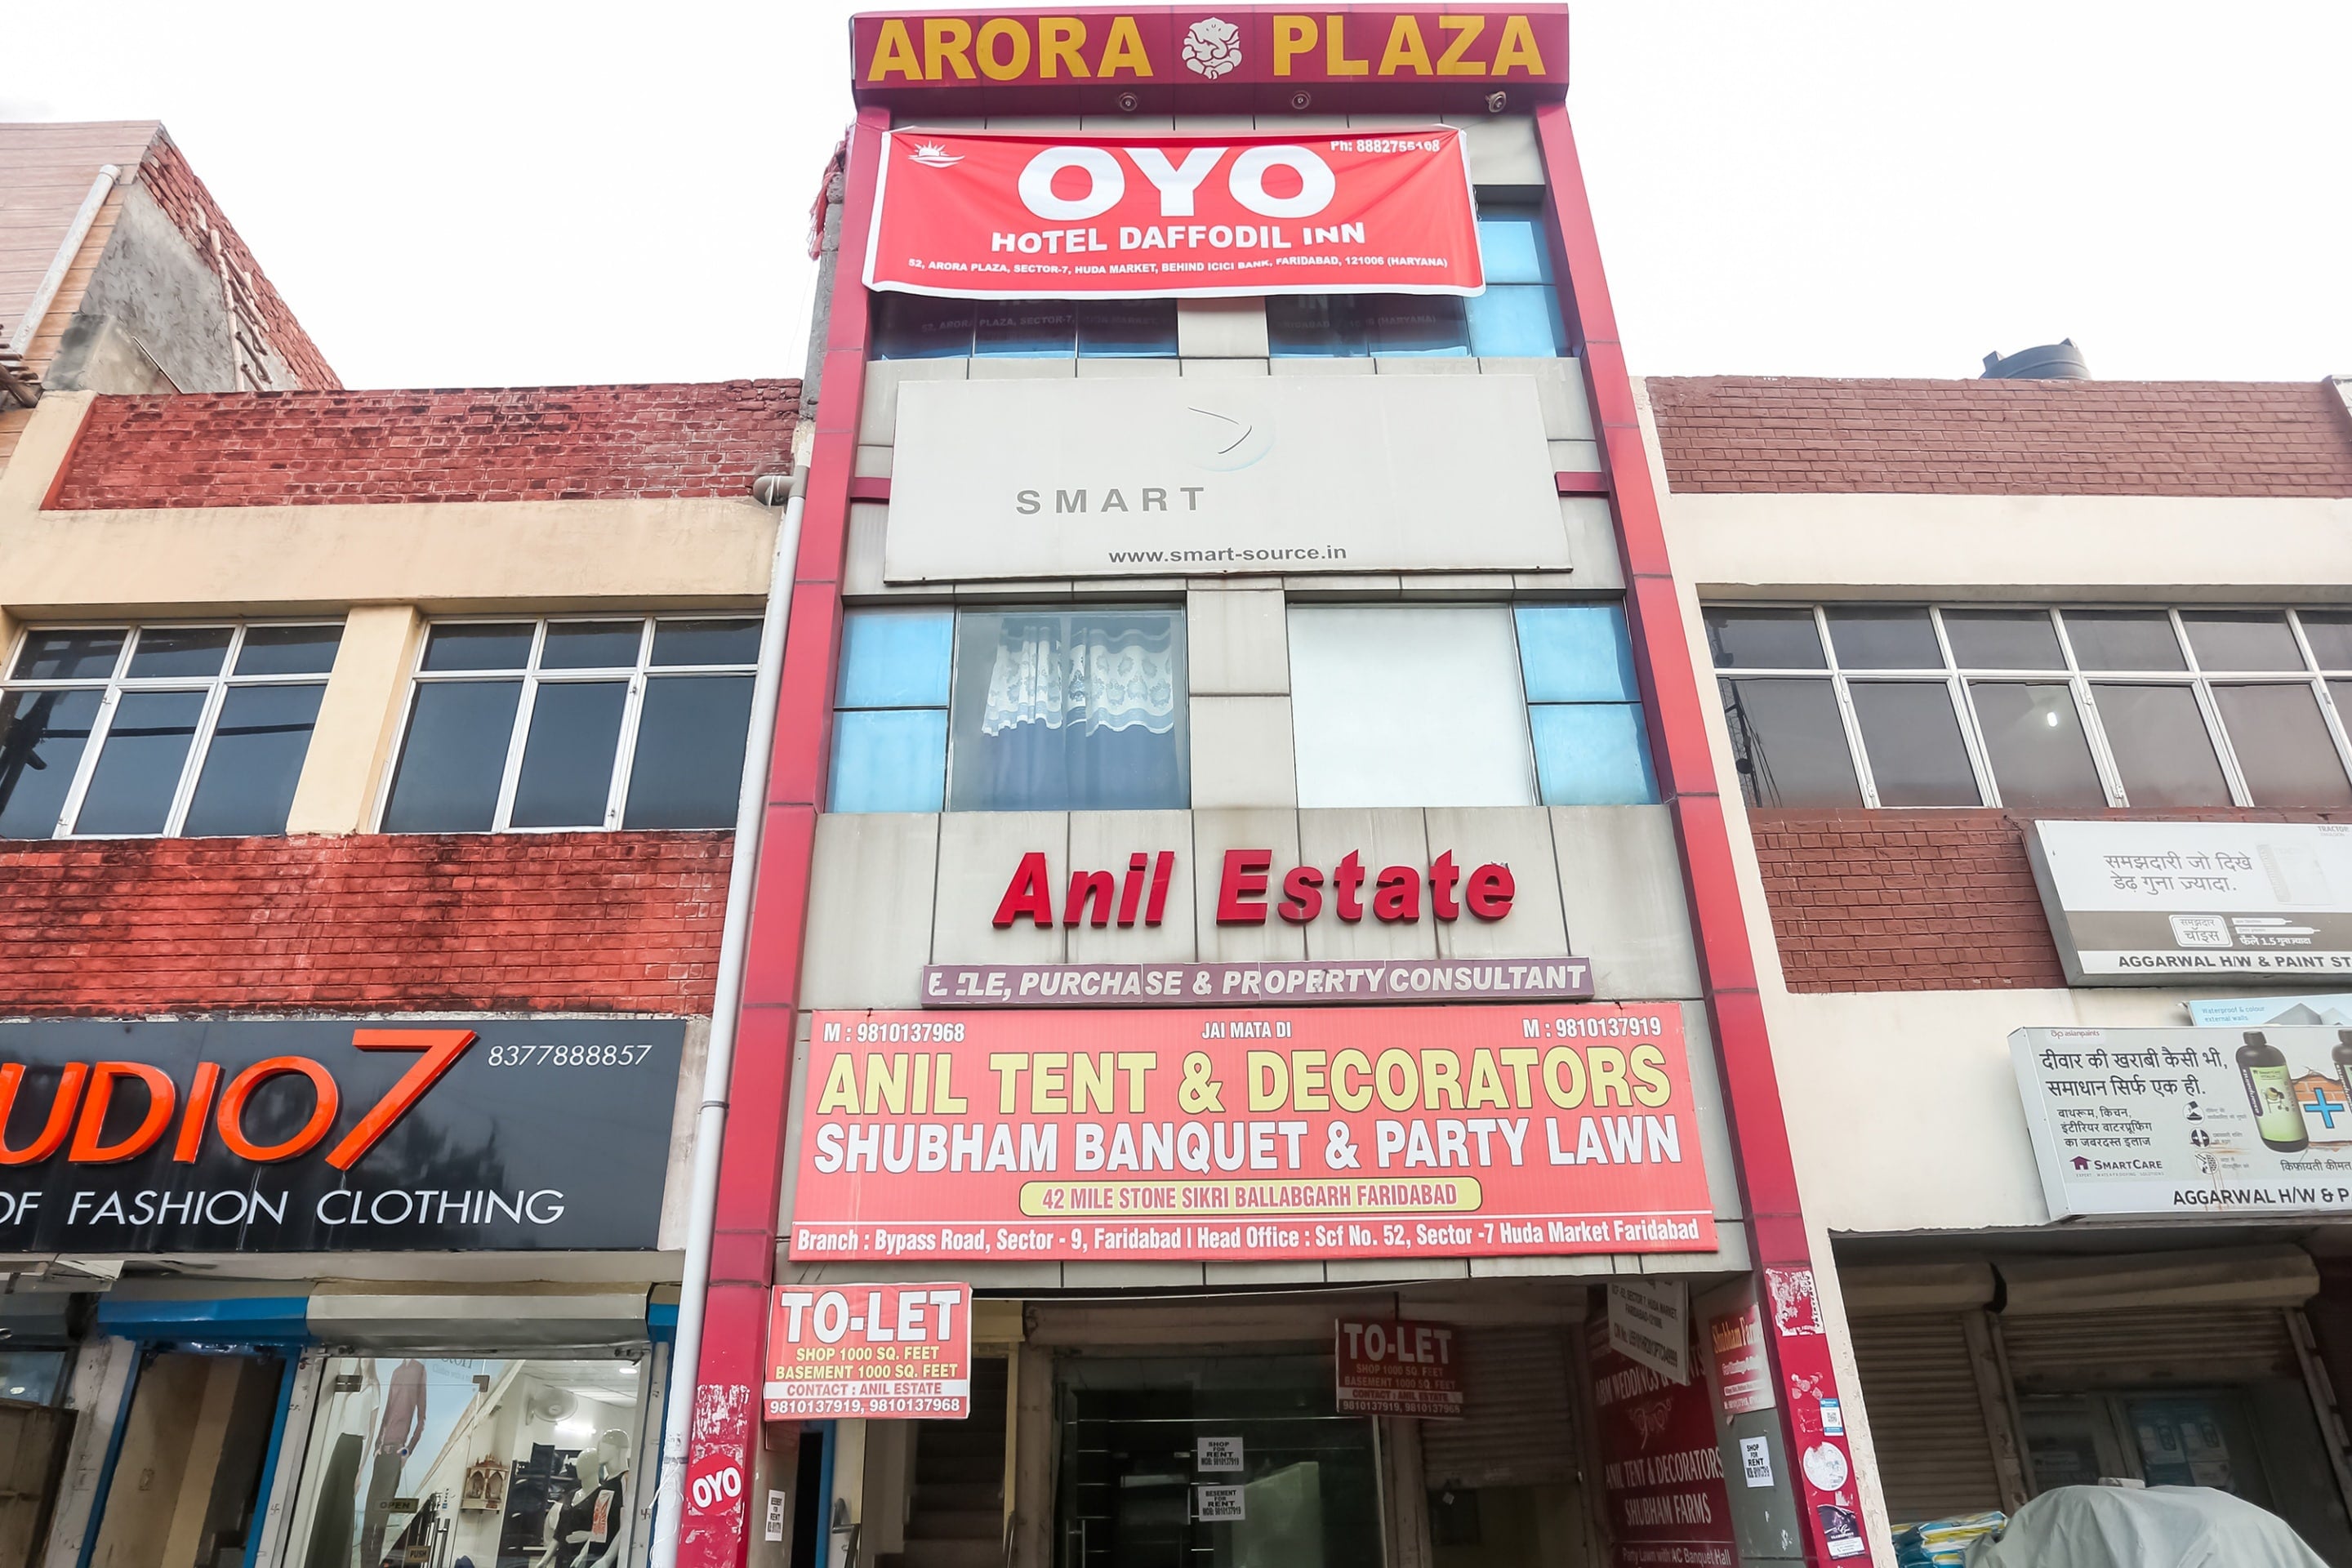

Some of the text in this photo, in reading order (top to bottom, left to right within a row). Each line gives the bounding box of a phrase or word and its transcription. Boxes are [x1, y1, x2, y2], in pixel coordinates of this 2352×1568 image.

[867, 15, 1546, 82] ARORA PLAZA
[1330, 140, 1353, 153] Ph:
[1018, 145, 1336, 221] OYO
[991, 222, 1365, 254] HOTEL DAFFODIL INN
[908, 256, 1448, 275] 52, ARORA PLAZA, SECTOR-7, HUDA MARKET, BEHIND ICICI BANK, FARIDABAD, 121006 (HARYANA)
[1016, 487, 1204, 514] SMART
[1108, 545, 1348, 563] www.smart-source.in
[2104, 851, 2253, 871] समझदारी जो दिखे
[992, 848, 1517, 929] Anil Estate
[2110, 871, 2138, 893] डेढ़
[2141, 876, 2175, 895] गुना
[2118, 956, 2324, 968] AGGARWAL H/W & PAINT
[1018, 965, 1586, 996] PURCHASE & PROPERTY CONSULTANT
[858, 1022, 965, 1043] 9810137968
[1202, 1020, 1291, 1040] JAI MATA DI
[1555, 1017, 1662, 1038] 9810137919
[488, 1044, 654, 1067] 8377888857
[2039, 1046, 2228, 1070] दीवार की खराबी कैसी भी,
[816, 1044, 1672, 1116] ANIL TENT & DECORATORS
[2046, 1074, 2206, 1097] समाधान सिर्फ एक ही.
[2099, 1105, 2132, 1118] किचन,
[813, 1114, 1682, 1175] SHUBHAM BANQUET & PARTY LAWN
[2064, 1137, 2151, 1148] का इलाज
[68, 1187, 565, 1225] FASHION CLOTHING
[1042, 1183, 1457, 1210] 42 MILE STONE SIKRI BALLABGARH FARIDABAD
[2173, 1186, 2334, 1205] AGGARWAL H/W &
[797, 1229, 858, 1251] Branch
[875, 1228, 936, 1254] Bypass
[941, 1227, 991, 1252] Road,
[996, 1227, 1054, 1250] Sector
[1071, 1227, 1088, 1252] 9,
[1094, 1226, 1181, 1250] Faridabad
[1197, 1226, 1241, 1249] Head
[1246, 1225, 1299, 1248] Office
[1316, 1224, 1346, 1247] Scf
[1348, 1224, 1377, 1246] No.
[1383, 1223, 1411, 1249] 52,
[1416, 1223, 1472, 1245] Sector
[1500, 1222, 1544, 1244] Huda
[1548, 1220, 1610, 1243] Market
[1614, 1218, 1699, 1241] Faridabad
[781, 1290, 961, 1343] TO-LET
[795, 1346, 939, 1361] SHOP 1000 SQ. FEET
[1343, 1323, 1452, 1364] TO-LET
[775, 1363, 958, 1379] BASEMENT 1000 SQ. FEET
[1356, 1364, 1379, 1374] SHOP
[1383, 1365, 1403, 1375] 1000
[1423, 1367, 1443, 1377] FEET
[786, 1383, 942, 1396] CONTACT ANIL ESTATE
[1344, 1376, 1392, 1388] BASEMENT
[1396, 1379, 1415, 1388] 1000
[1435, 1380, 1456, 1390] FEET
[770, 1398, 960, 1415] 9810137919, 9810137968
[1352, 1390, 1449, 1402] CONTACT ANIL ESTATE
[1746, 1444, 1759, 1452] SHOP
[1606, 1463, 1624, 1490] ANIL
[1624, 1459, 1646, 1488] TENT
[1655, 1446, 1725, 1484] DECORATORS
[1748, 1458, 1763, 1467] RENT
[693, 1467, 742, 1508] OYO
[380, 1501, 411, 1509] OPEN
[1624, 1492, 1712, 1527] SHUBHAM FARMS
[410, 1549, 428, 1559] PUSH
[1671, 1548, 1683, 1563] AC
[1684, 1547, 1714, 1568] Banquet
[1715, 1548, 1731, 1566] Hall
